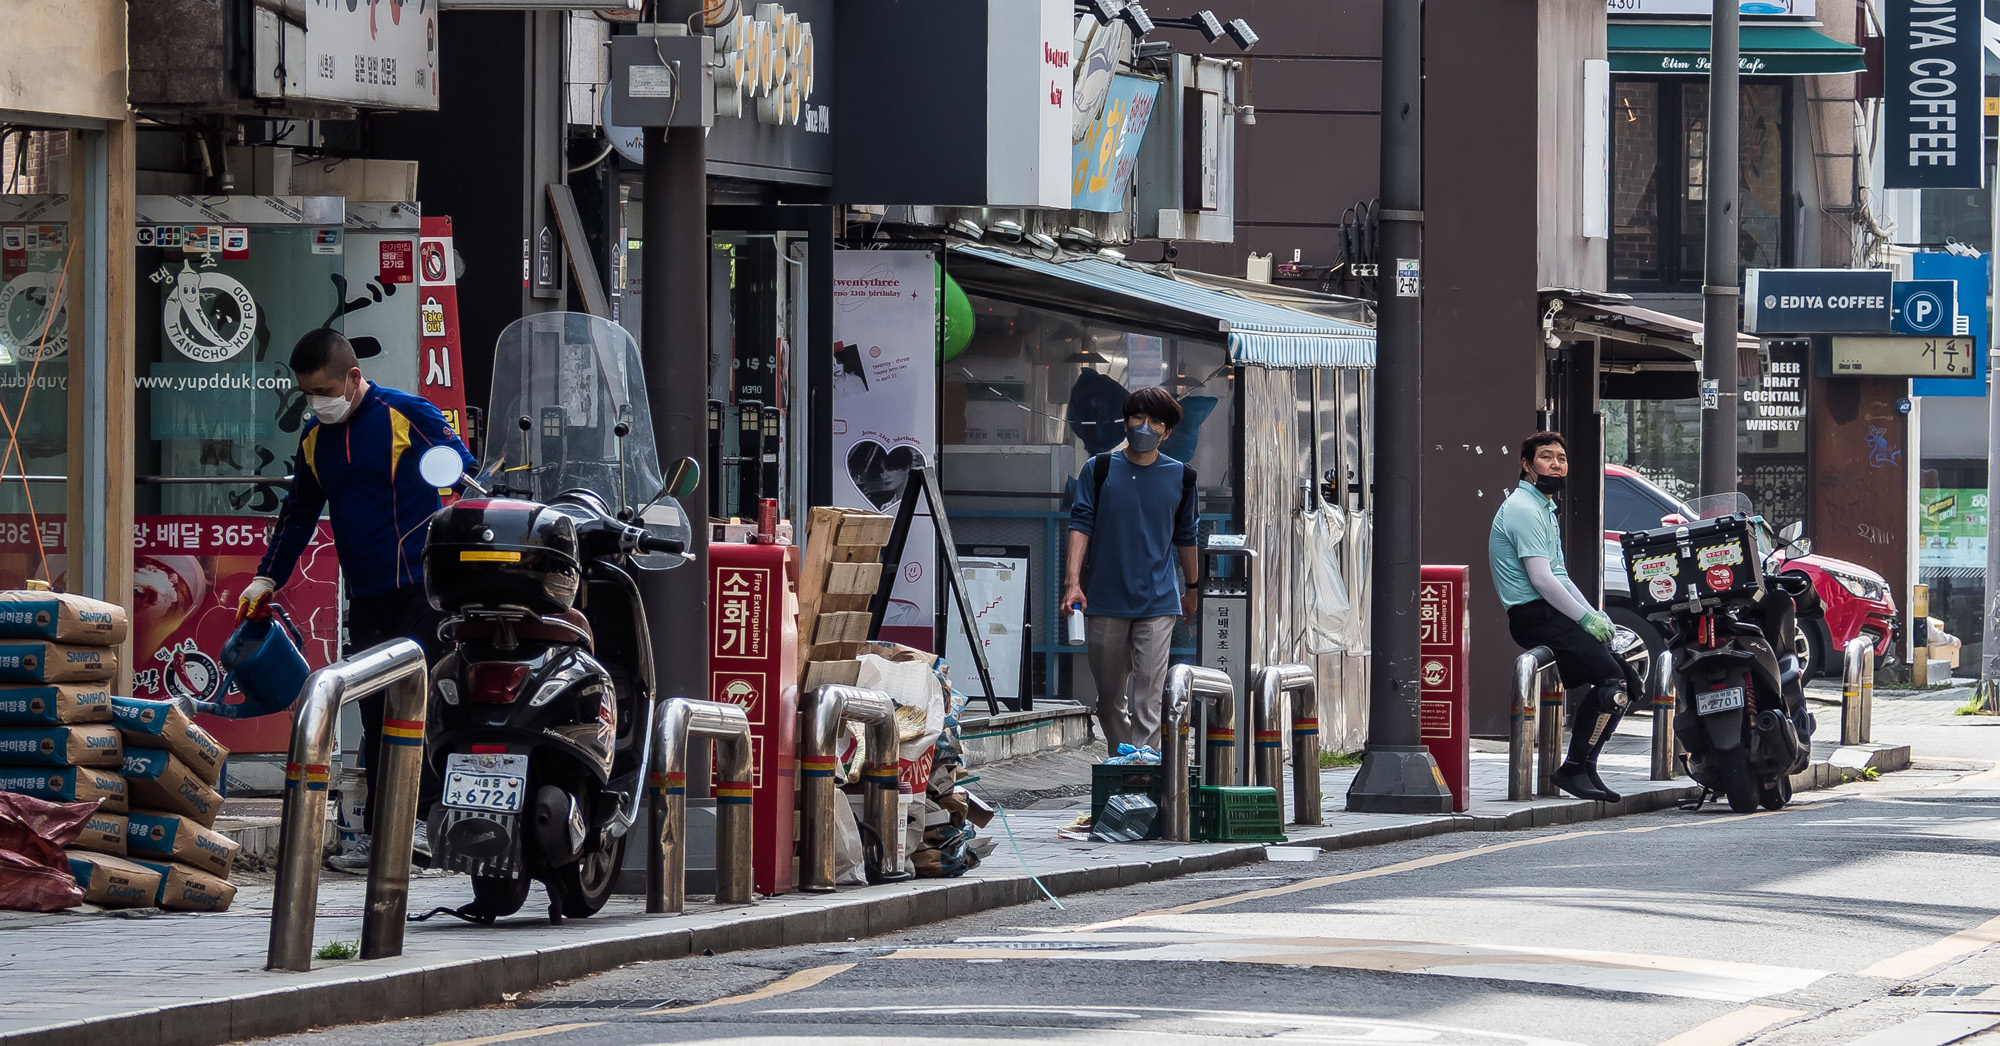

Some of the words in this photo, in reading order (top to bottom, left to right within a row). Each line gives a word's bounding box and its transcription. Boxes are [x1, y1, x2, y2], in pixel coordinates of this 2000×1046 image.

[1910, 0, 1957, 49] IYA
[1661, 56, 1690, 69] Elim
[1695, 57, 1711, 69] Sa
[805, 104, 818, 133] Since
[1909, 58, 1957, 166] COFFEE
[264, 199, 302, 222] STAINLESS
[157, 232, 180, 240] JCB
[382, 260, 404, 269] 요기요
[833, 278, 900, 288] twentythree
[233, 286, 254, 319] FOOD
[869, 290, 901, 298] birthday
[1780, 296, 1824, 309] EDIYA
[1827, 296, 1885, 309] COFFEE
[422, 310, 443, 324] Take
[1916, 300, 1932, 322] P
[233, 323, 253, 349] HOT
[426, 321, 441, 333] out
[169, 322, 228, 359] TTANGCHO
[1771, 362, 1800, 374] BEER
[134, 373, 292, 391] www.yupdduk.com
[1763, 377, 1800, 388] DRAFT
[1743, 391, 1800, 402] COCKTAIL
[1759, 405, 1800, 416] VODKA
[1746, 419, 1800, 431] WHISKEY
[754, 573, 762, 591] Fire
[722, 572, 750, 655] 소화기
[1421, 584, 1439, 642] 소화기
[1440, 599, 1448, 642] Extinguisher
[751, 594, 762, 654] Extinguisher
[1217, 606, 1229, 650] 담배꽁초
[1708, 696, 1738, 710] 2701
[473, 779, 489, 788] 서울
[465, 788, 517, 807] 6724
